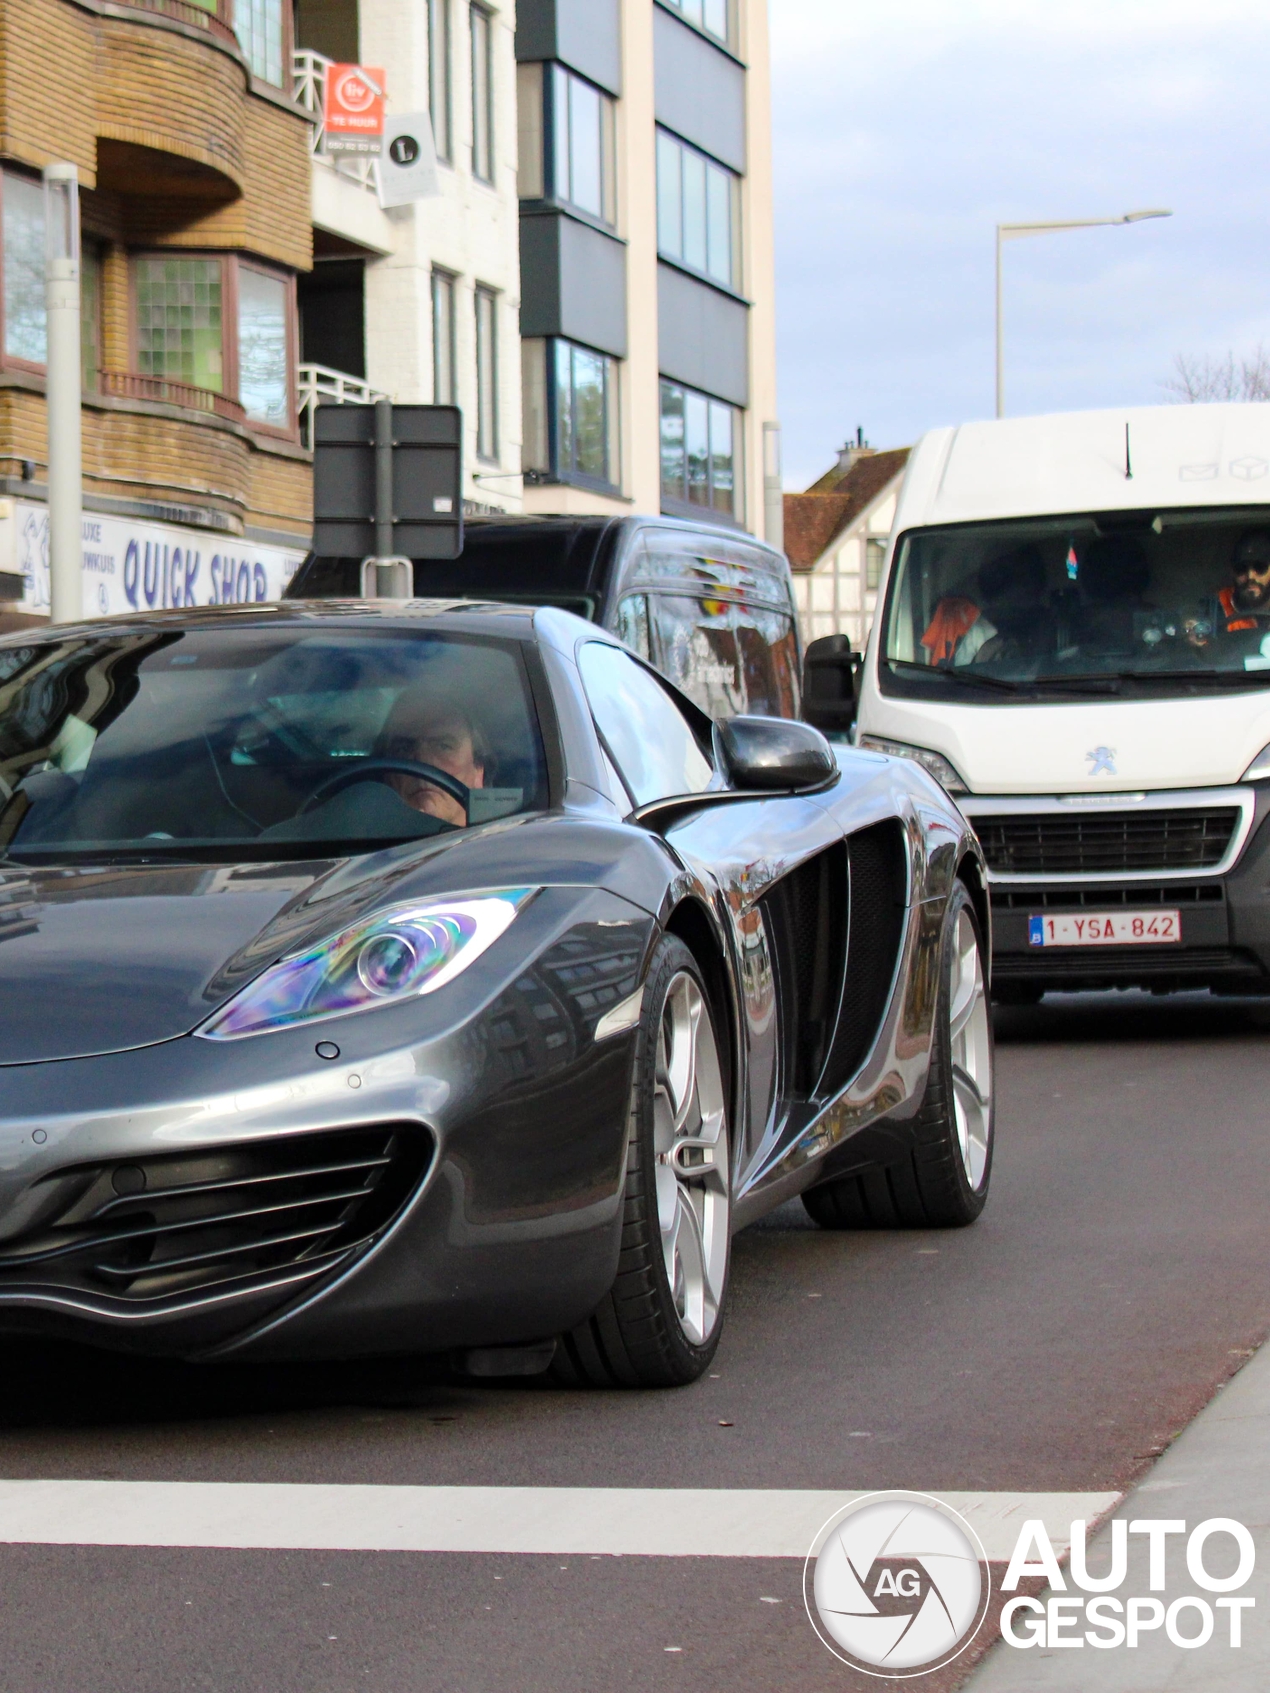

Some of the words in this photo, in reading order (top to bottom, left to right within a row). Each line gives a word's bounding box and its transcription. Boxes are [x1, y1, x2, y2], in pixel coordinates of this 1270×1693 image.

[331, 116, 347, 127] TE
[349, 117, 379, 128] HUUR
[396, 140, 414, 162] L
[123, 538, 201, 612] QUICK
[209, 553, 268, 606] SHOP
